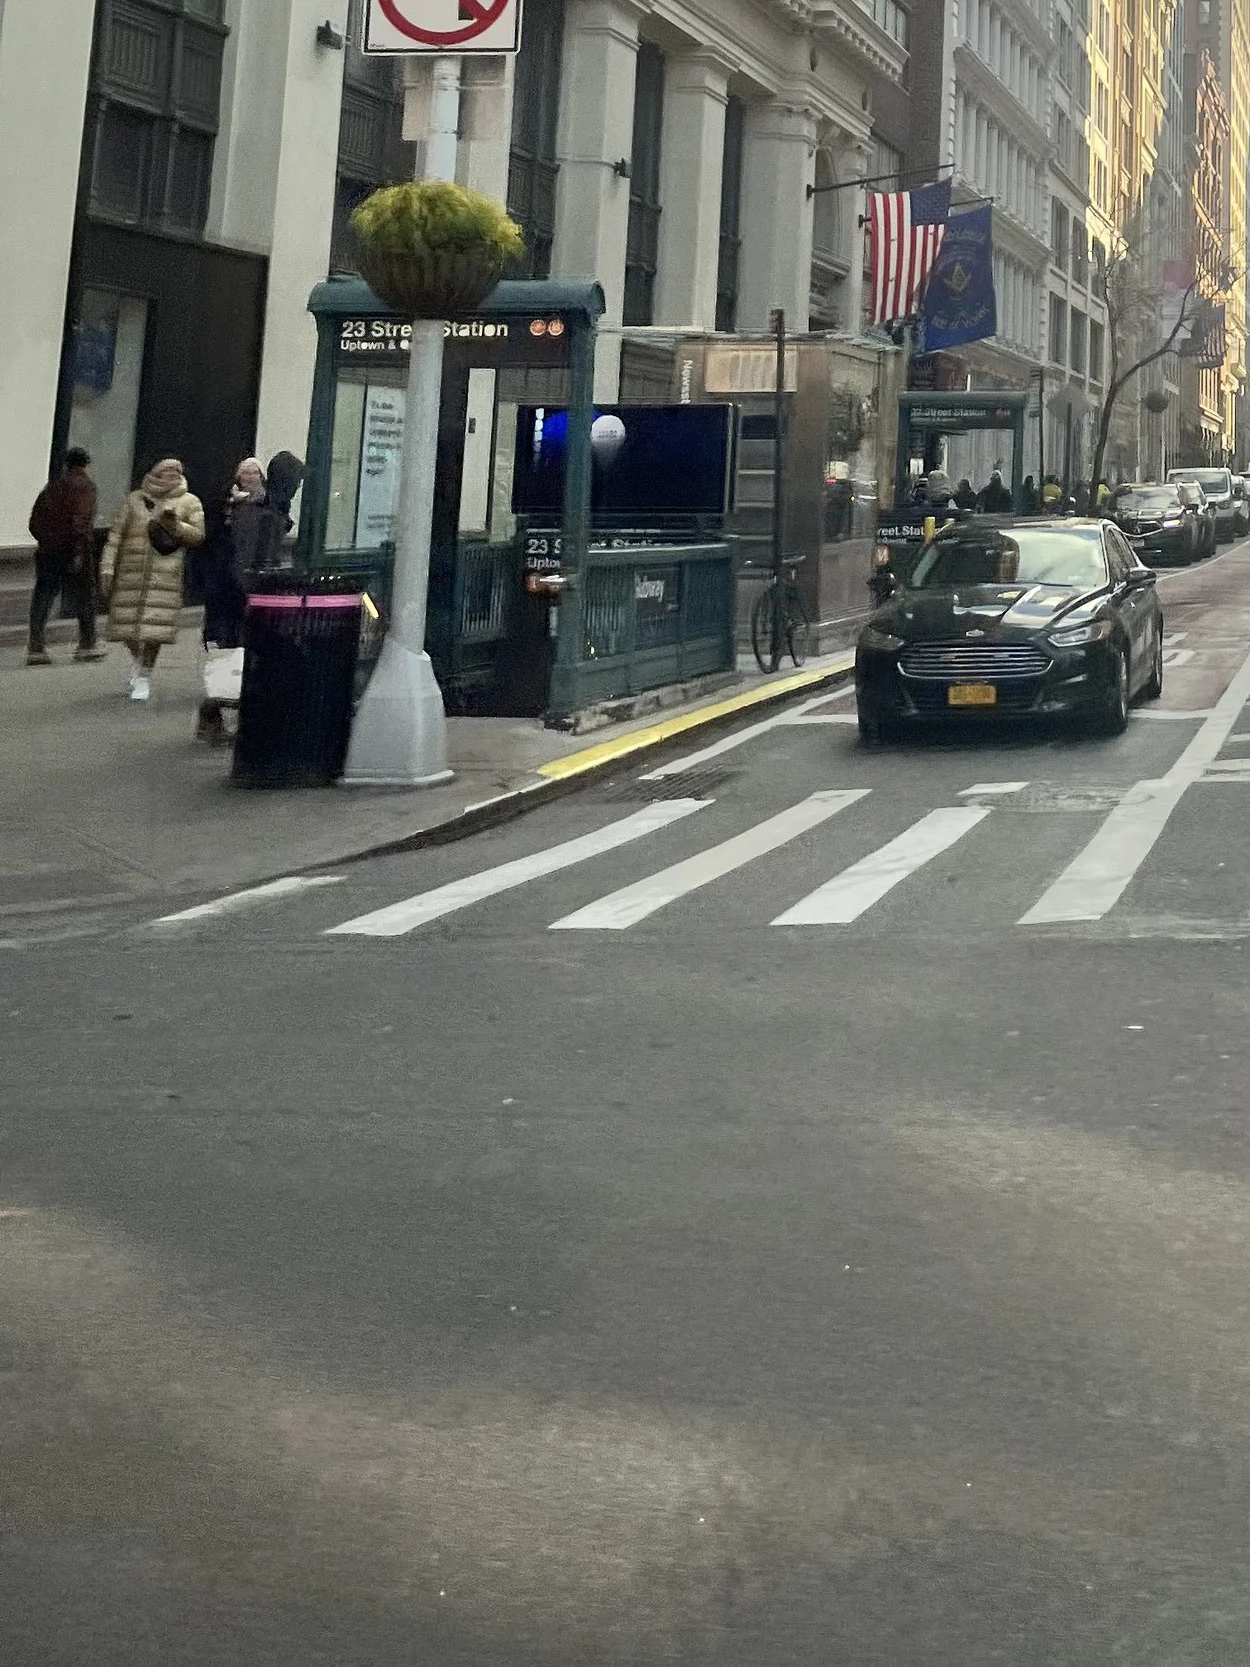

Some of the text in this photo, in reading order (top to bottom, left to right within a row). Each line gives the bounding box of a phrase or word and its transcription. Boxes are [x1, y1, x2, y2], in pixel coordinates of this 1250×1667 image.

[342, 321, 366, 337] 23
[371, 321, 412, 337] Stre
[341, 340, 385, 351] Uptown
[681, 360, 693, 404] Newsst
[877, 526, 899, 536] reet
[527, 538, 548, 554] 23
[527, 557, 561, 570] Upto
